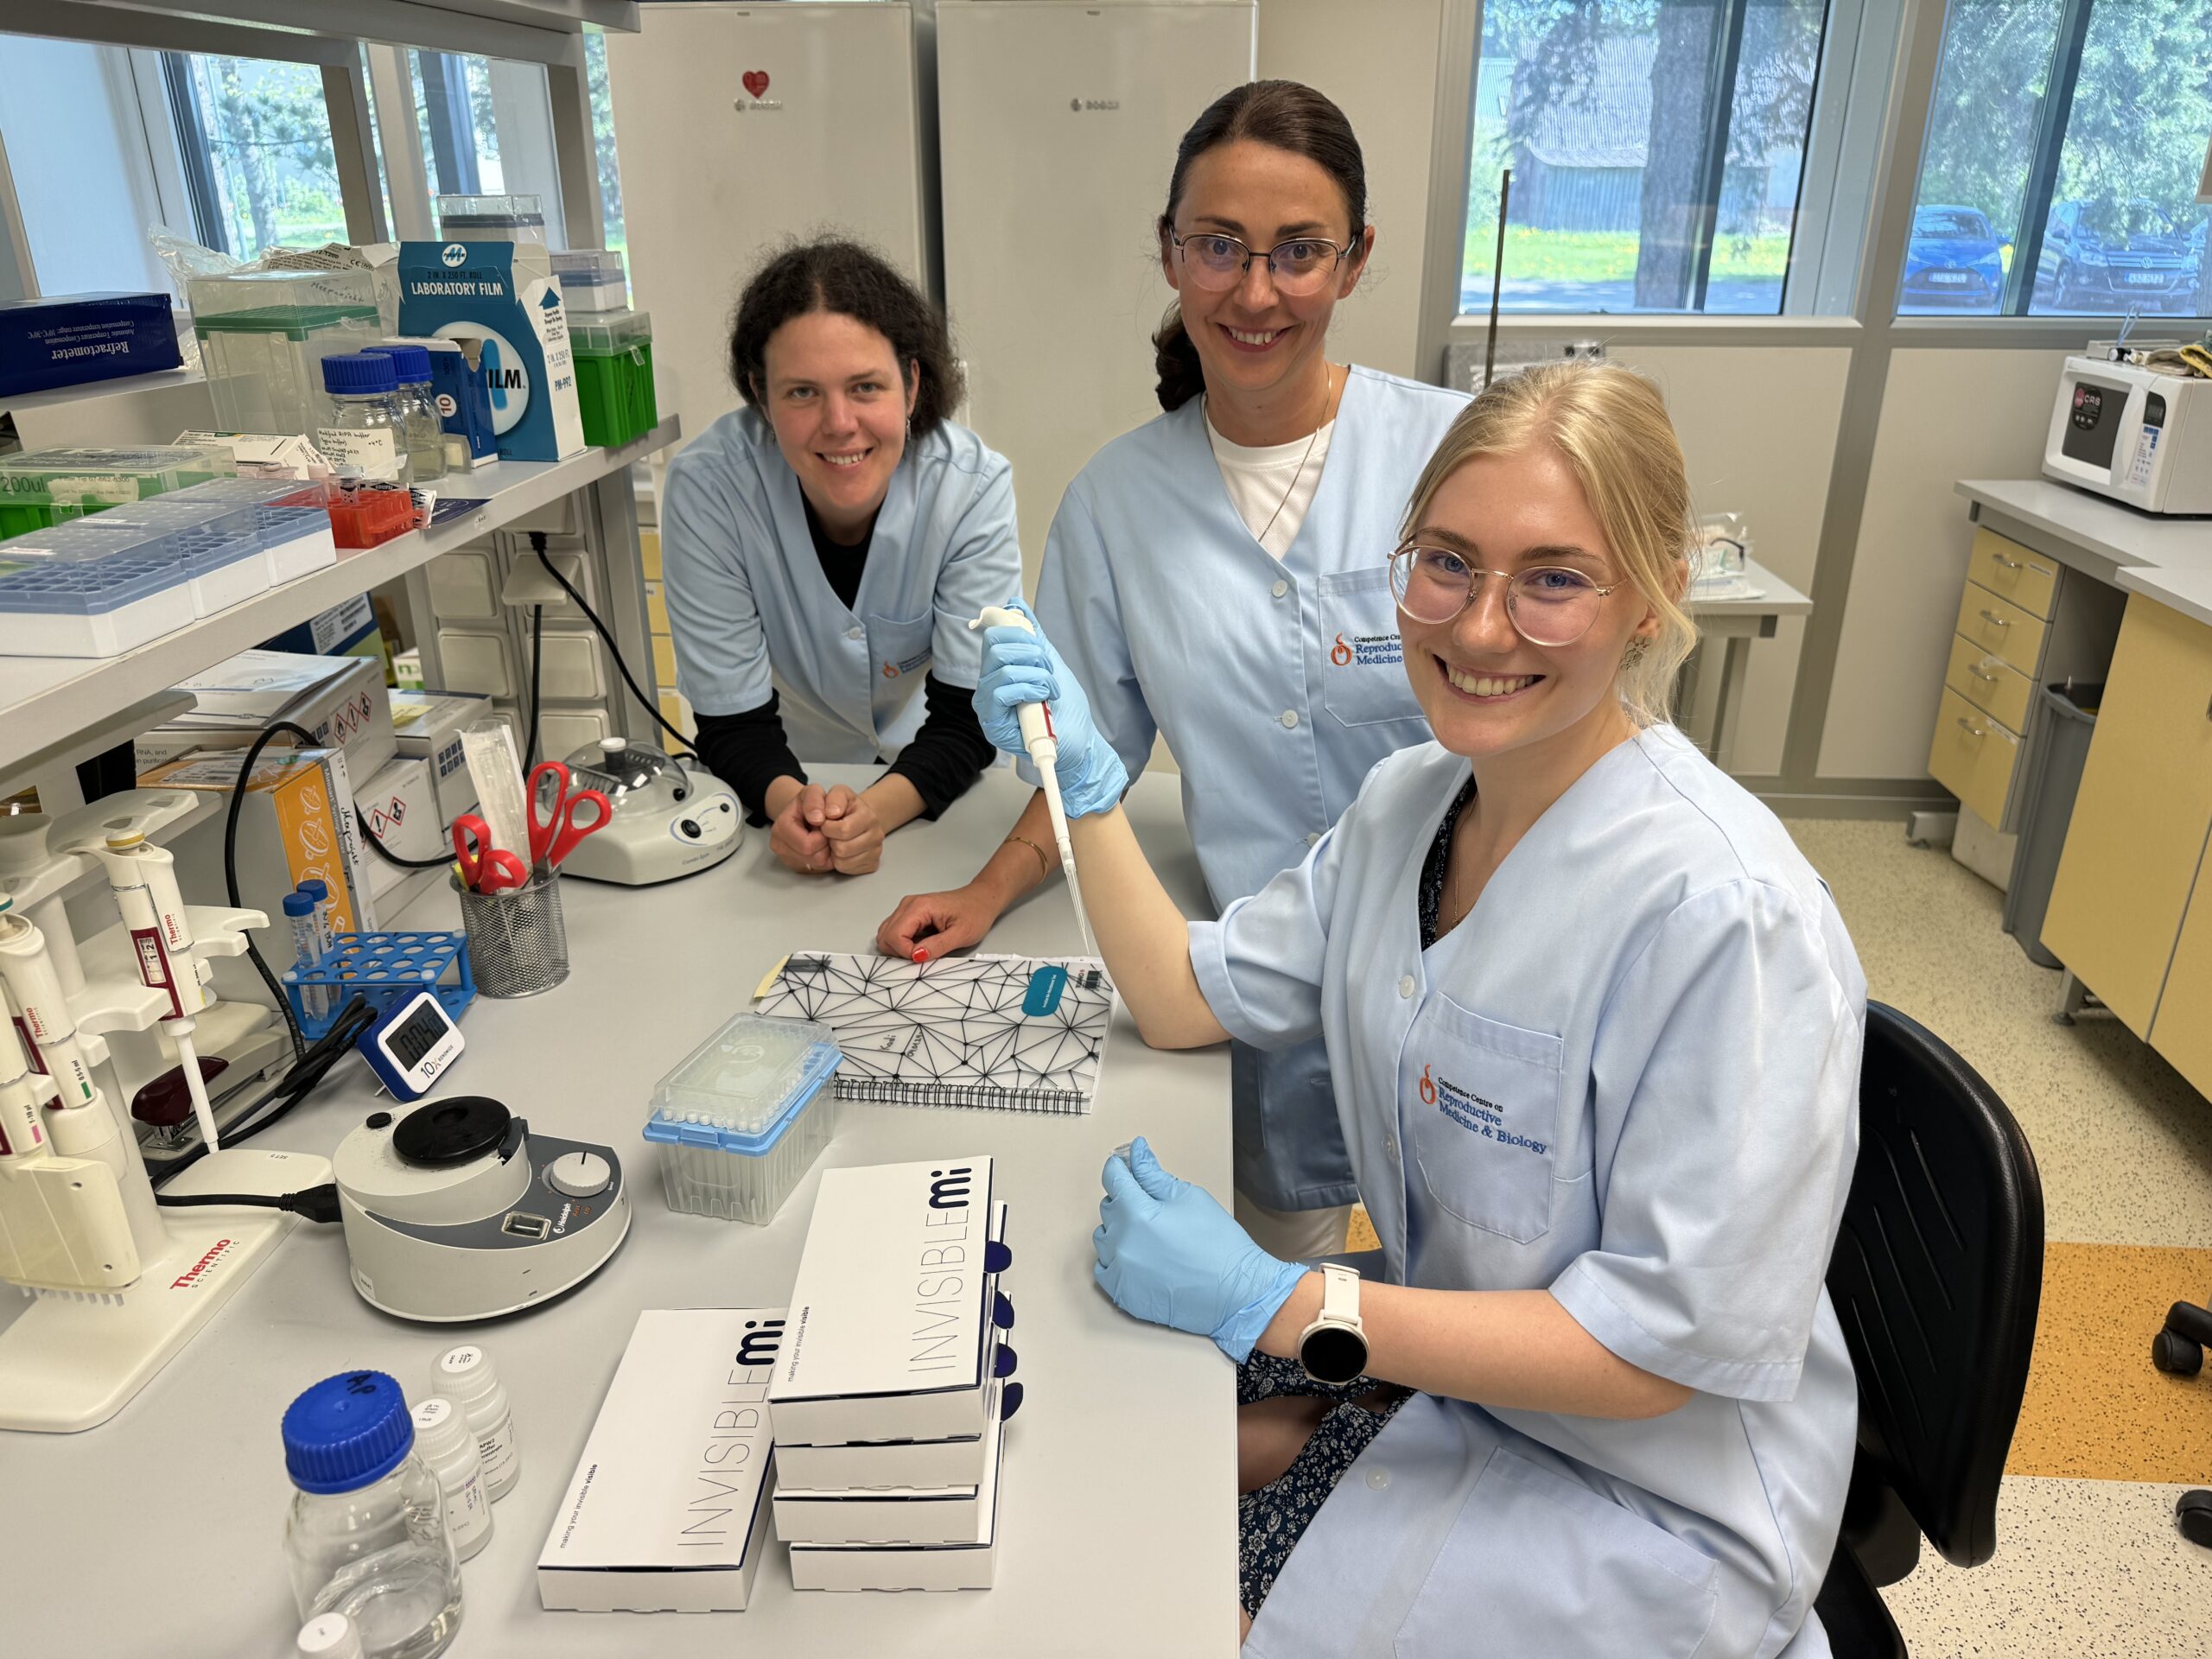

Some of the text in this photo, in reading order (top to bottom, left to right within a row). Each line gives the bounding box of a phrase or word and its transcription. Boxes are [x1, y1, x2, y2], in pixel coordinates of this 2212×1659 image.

[411, 282, 504, 296] LABORATORY FILM
[52, 341, 130, 359] Refractometer
[439, 397, 451, 414] 10
[1356, 642, 1402, 654] Reproduc
[1357, 654, 1403, 665] Medicine
[165, 914, 178, 944] Thermo
[26, 1007, 43, 1039] Thermo
[1439, 1077, 1503, 1113] Competence Centre on
[1439, 1085, 1502, 1126] Reproductive
[1439, 1100, 1547, 1154] Medicine & Biology
[557, 1203, 571, 1226] Heidolph
[169, 1239, 240, 1289] Thermo SCIENTIFIC
[800, 1306, 810, 1324] visible
[796, 1325, 805, 1346] invisible
[788, 1362, 798, 1382] making
[560, 1525, 575, 1548] making
[574, 1485, 588, 1509] invisible
[585, 1464, 597, 1484] visible
